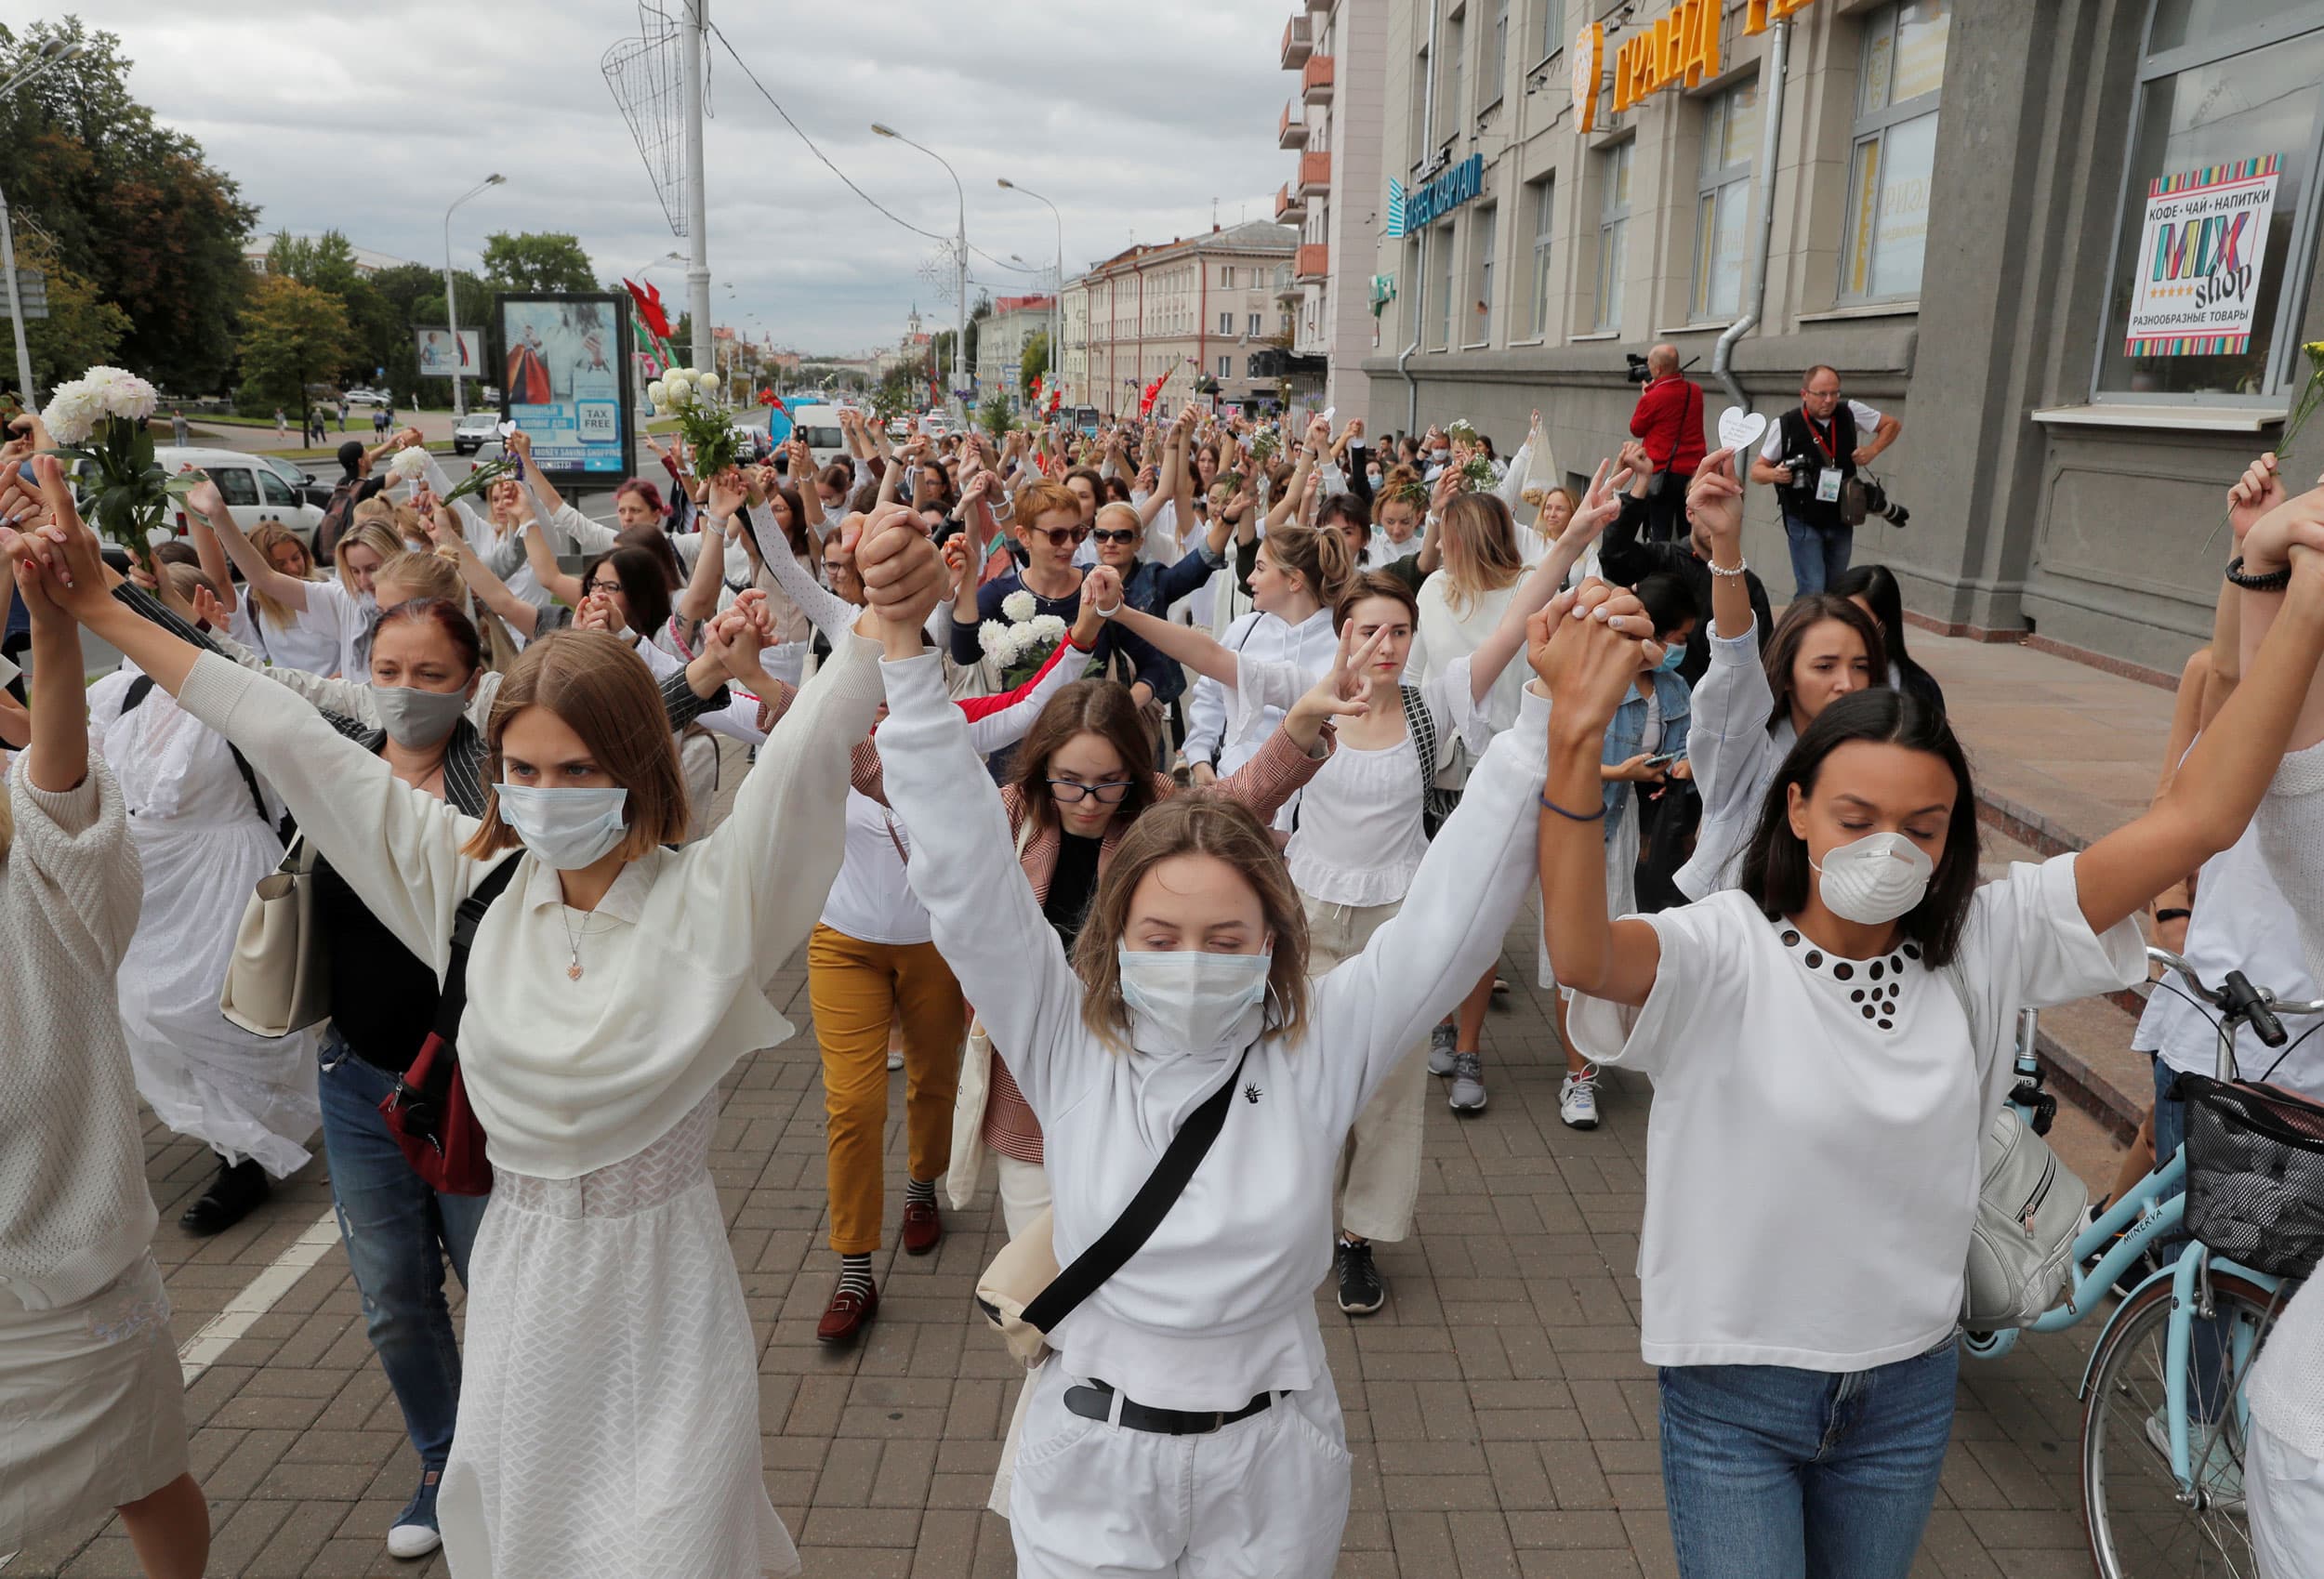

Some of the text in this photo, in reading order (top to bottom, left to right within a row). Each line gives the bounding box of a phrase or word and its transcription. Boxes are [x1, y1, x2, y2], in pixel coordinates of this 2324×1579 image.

[1612, 0, 1720, 112] ГРАНД
[2149, 189, 2270, 221] КОФЕ ЧАЙ НАПИТКИ
[2152, 211, 2251, 282] MIX
[2195, 264, 2251, 309] shop
[2133, 309, 2249, 325] РАЗНООБРАЗНЫЕ ТОВАРЫ
[585, 419, 610, 428] FREE
[587, 410, 608, 418] TAX
[535, 448, 559, 456] MONEY
[2123, 1208, 2163, 1244] MINERVA
